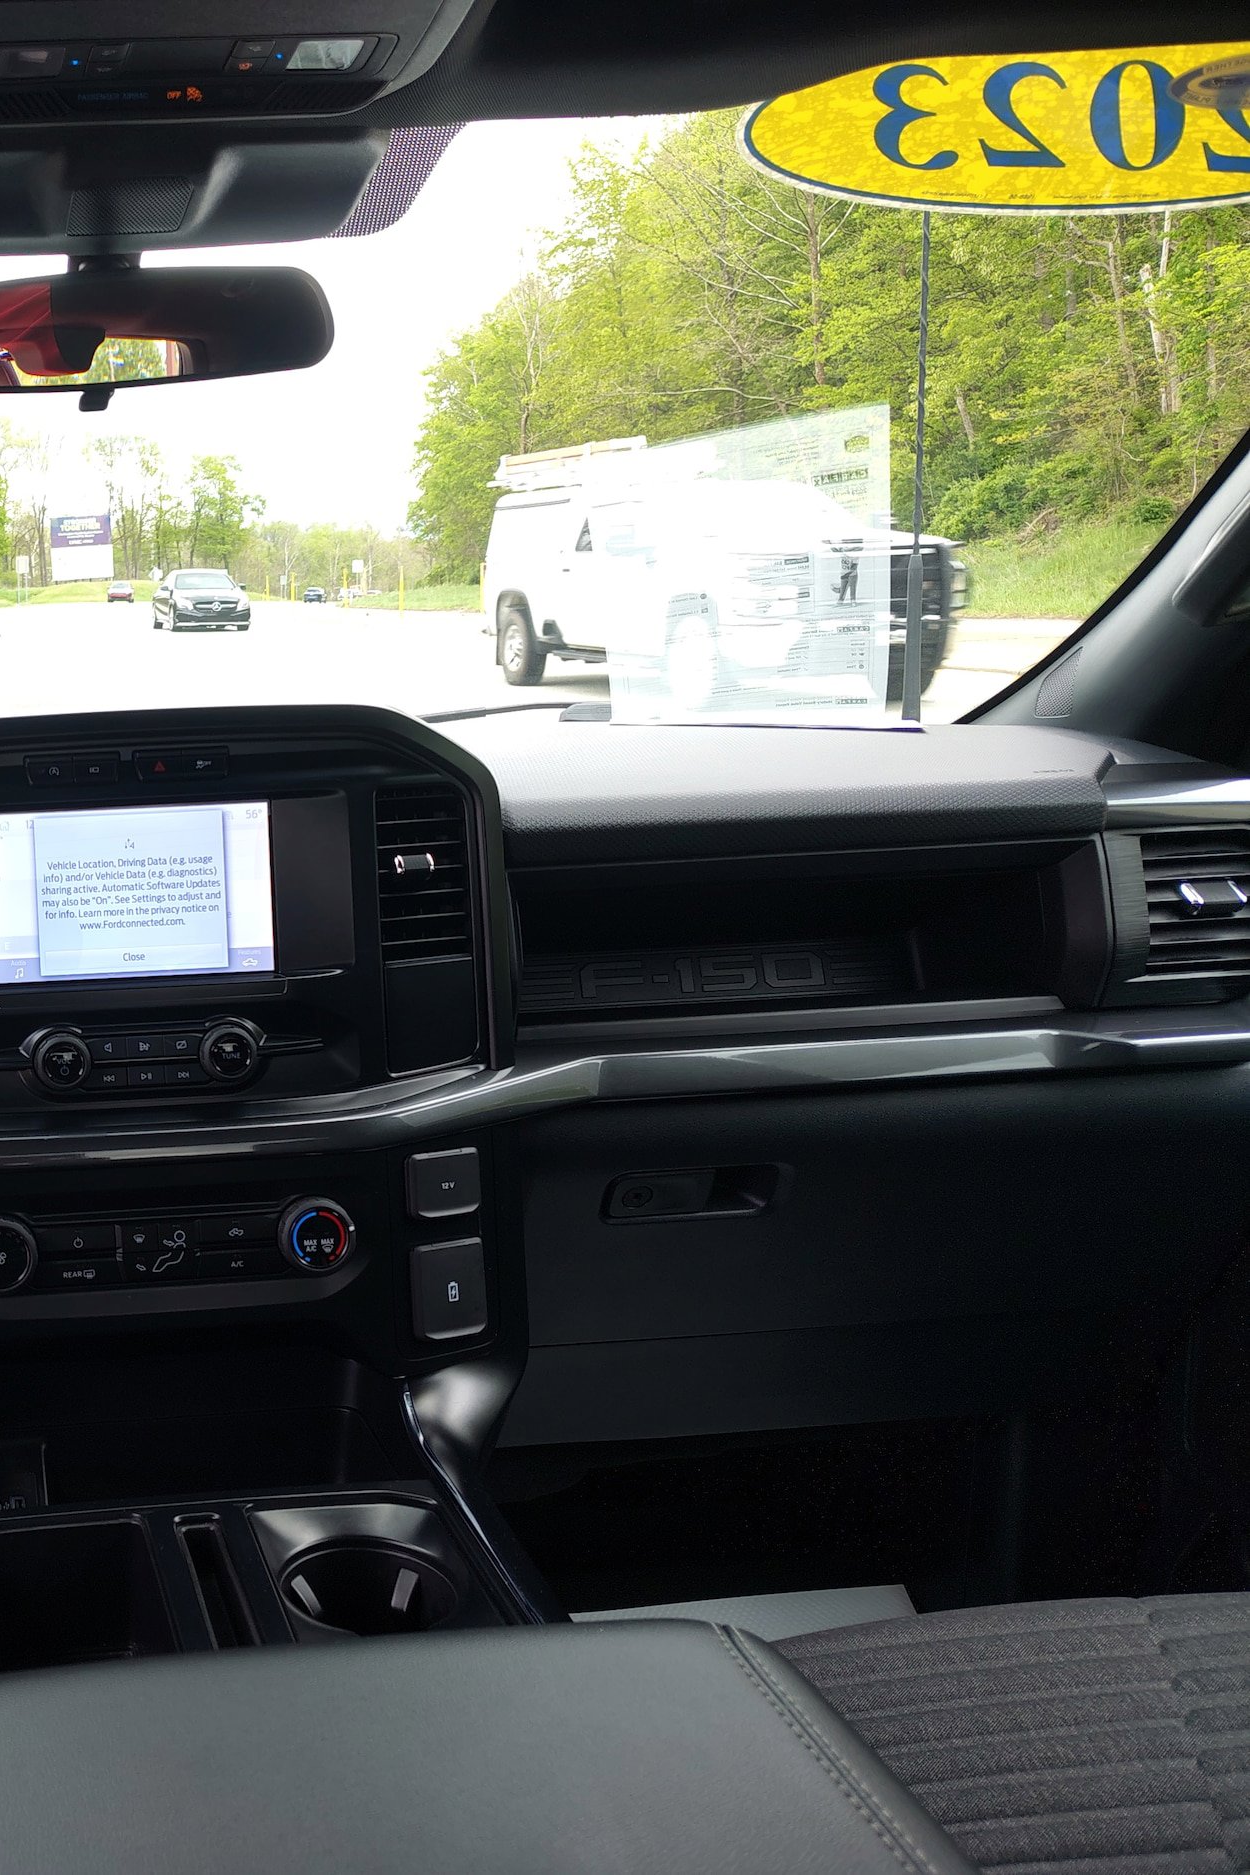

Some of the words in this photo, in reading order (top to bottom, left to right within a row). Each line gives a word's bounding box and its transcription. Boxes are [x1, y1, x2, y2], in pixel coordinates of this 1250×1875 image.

[166, 90, 181, 100] OFF
[245, 808, 262, 820] 56°
[47, 861, 77, 870] Vehicle
[78, 859, 116, 870] Location,
[118, 858, 146, 868] Driving
[148, 857, 167, 866] Data
[168, 856, 187, 866] (e.g.
[188, 855, 213, 866] usage
[43, 873, 63, 884] info)
[65, 871, 93, 882] and/or
[96, 870, 124, 881] Vehicle
[126, 869, 146, 879] Data
[148, 869, 166, 879] (e.g.
[167, 866, 217, 878] diagnostics)
[41, 885, 72, 896] sharing
[73, 883, 100, 893] active.
[102, 881, 145, 892] Automatic
[147, 880, 184, 890] Software
[186, 879, 221, 890] Updates
[42, 899, 60, 908] may
[61, 897, 79, 906] also
[80, 896, 90, 906] be
[115, 894, 130, 904] See
[132, 893, 166, 904] Settings
[168, 892, 176, 901] to
[177, 890, 204, 902] adjust
[205, 889, 221, 899] and
[45, 910, 57, 919] for
[58, 909, 77, 919] info.
[78, 908, 102, 918] Learn
[103, 908, 125, 917] more
[126, 906, 134, 915] in
[135, 905, 150, 915] the
[151, 905, 180, 916] privacy
[181, 903, 207, 913] notice
[208, 903, 219, 912] on
[79, 917, 186, 930] www.Fordconnected.com.
[122, 952, 145, 962] Close
[579, 951, 826, 999] F-150
[306, 1245, 317, 1253] A/C
[230, 1260, 244, 1268] A/C
[62, 1271, 83, 1279] REAR
